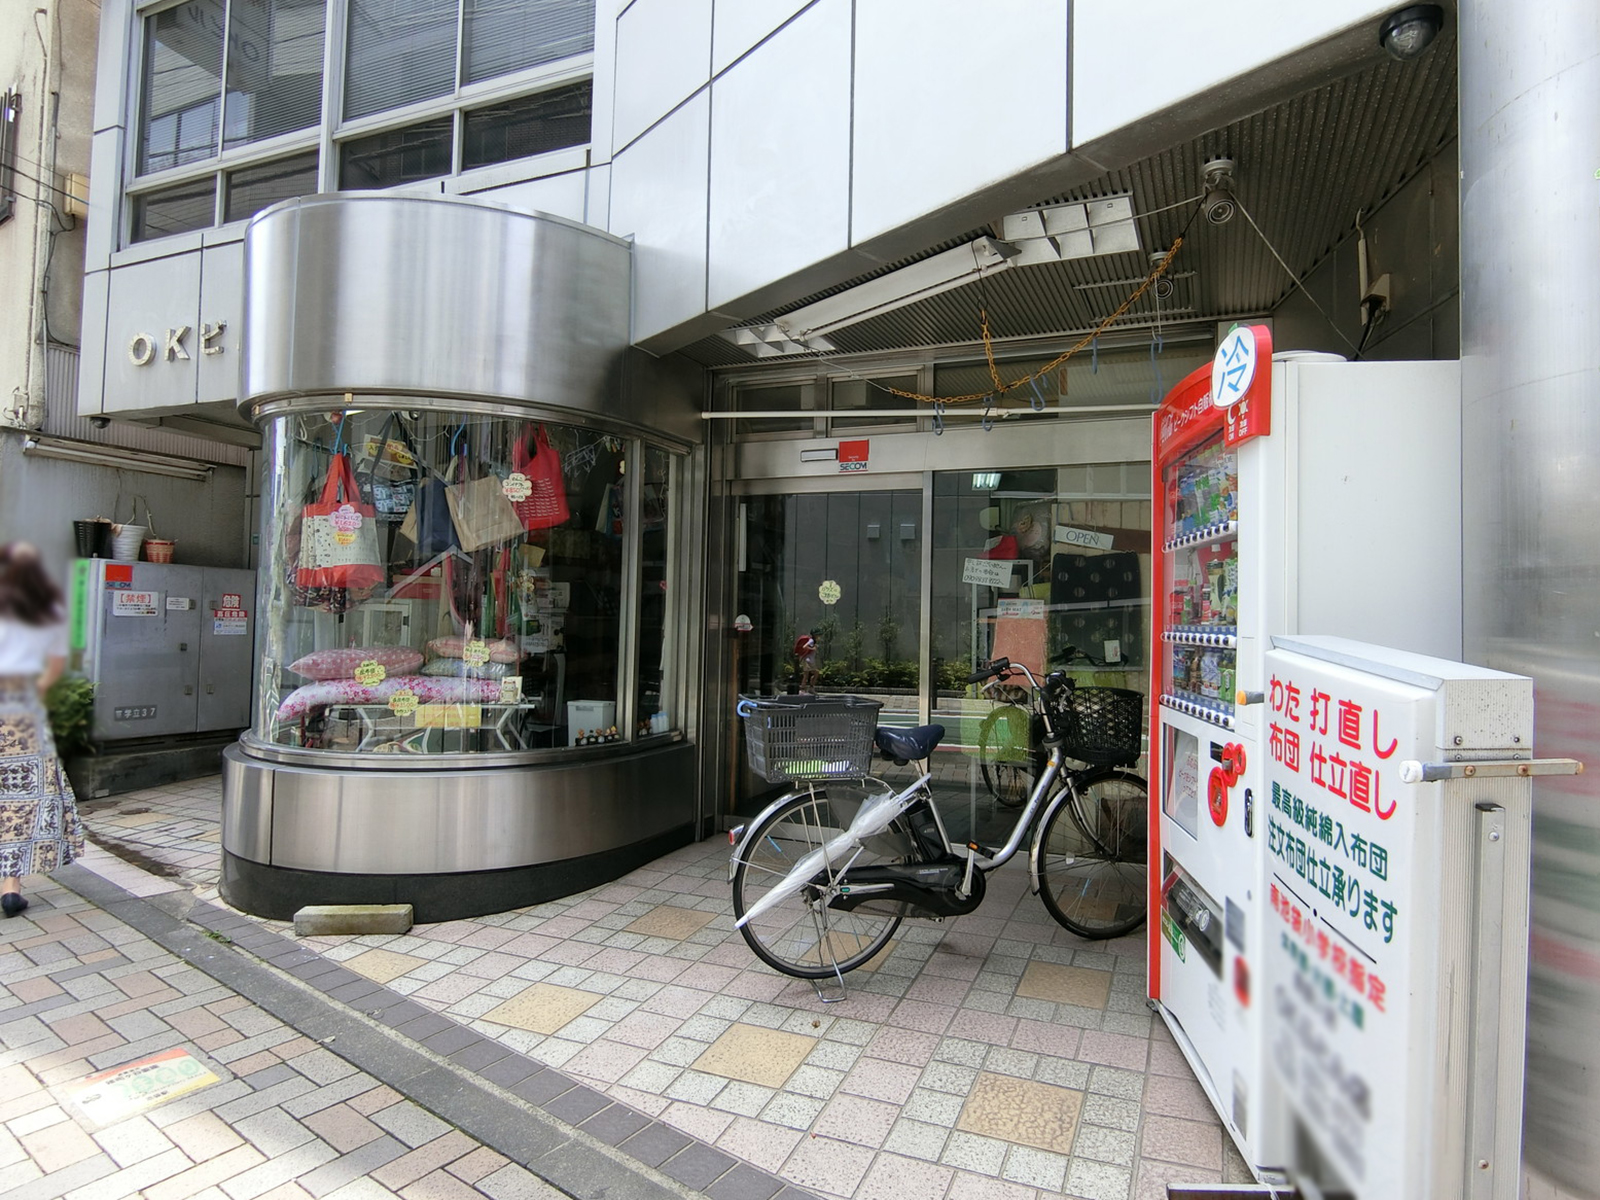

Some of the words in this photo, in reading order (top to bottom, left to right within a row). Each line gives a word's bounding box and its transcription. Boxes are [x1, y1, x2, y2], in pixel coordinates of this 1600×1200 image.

[128, 319, 229, 367] OKビ
[1216, 334, 1250, 400] 冷
[839, 461, 868, 471] SECOM
[1065, 529, 1100, 546] OPEN
[222, 594, 240, 608] 危険
[1269, 674, 1301, 723] わた
[1309, 687, 1398, 760] 打直し
[1269, 722, 1301, 773] 布団
[1309, 740, 1398, 821] 仕立直し
[1271, 780, 1388, 882] 最高級純綿入布団
[1267, 815, 1398, 944] 注文布団仕立承ります
